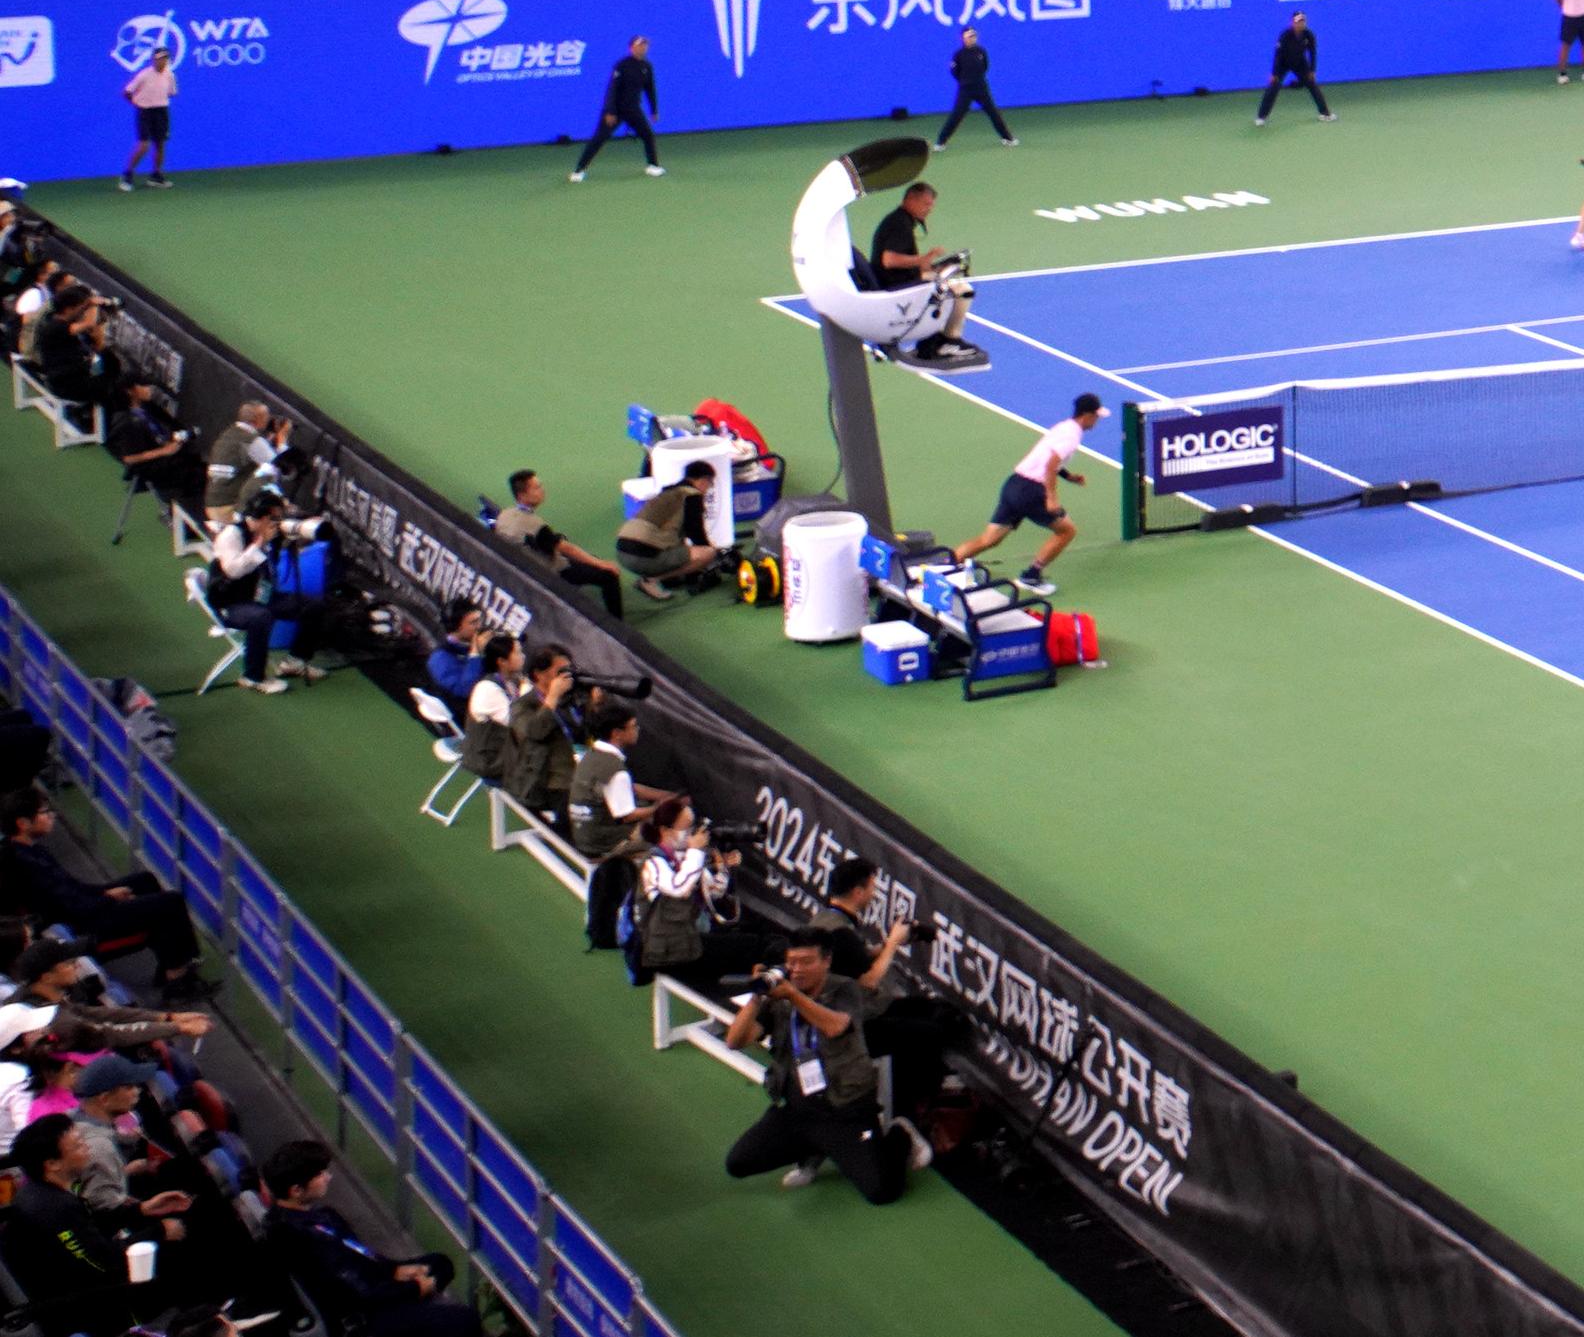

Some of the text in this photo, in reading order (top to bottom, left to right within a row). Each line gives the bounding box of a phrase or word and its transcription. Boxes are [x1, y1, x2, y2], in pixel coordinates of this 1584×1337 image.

[190, 17, 269, 42] WTA
[192, 42, 266, 68] 1000
[460, 39, 586, 71] 中国光谷
[1033, 190, 1272, 223] WUHAN
[1162, 423, 1275, 460] HOLOGIC
[755, 785, 917, 958] 2024东岚图
[931, 911, 1192, 1160] 武汉网球公开赛
[1082, 1110, 1184, 1216] OPEN
